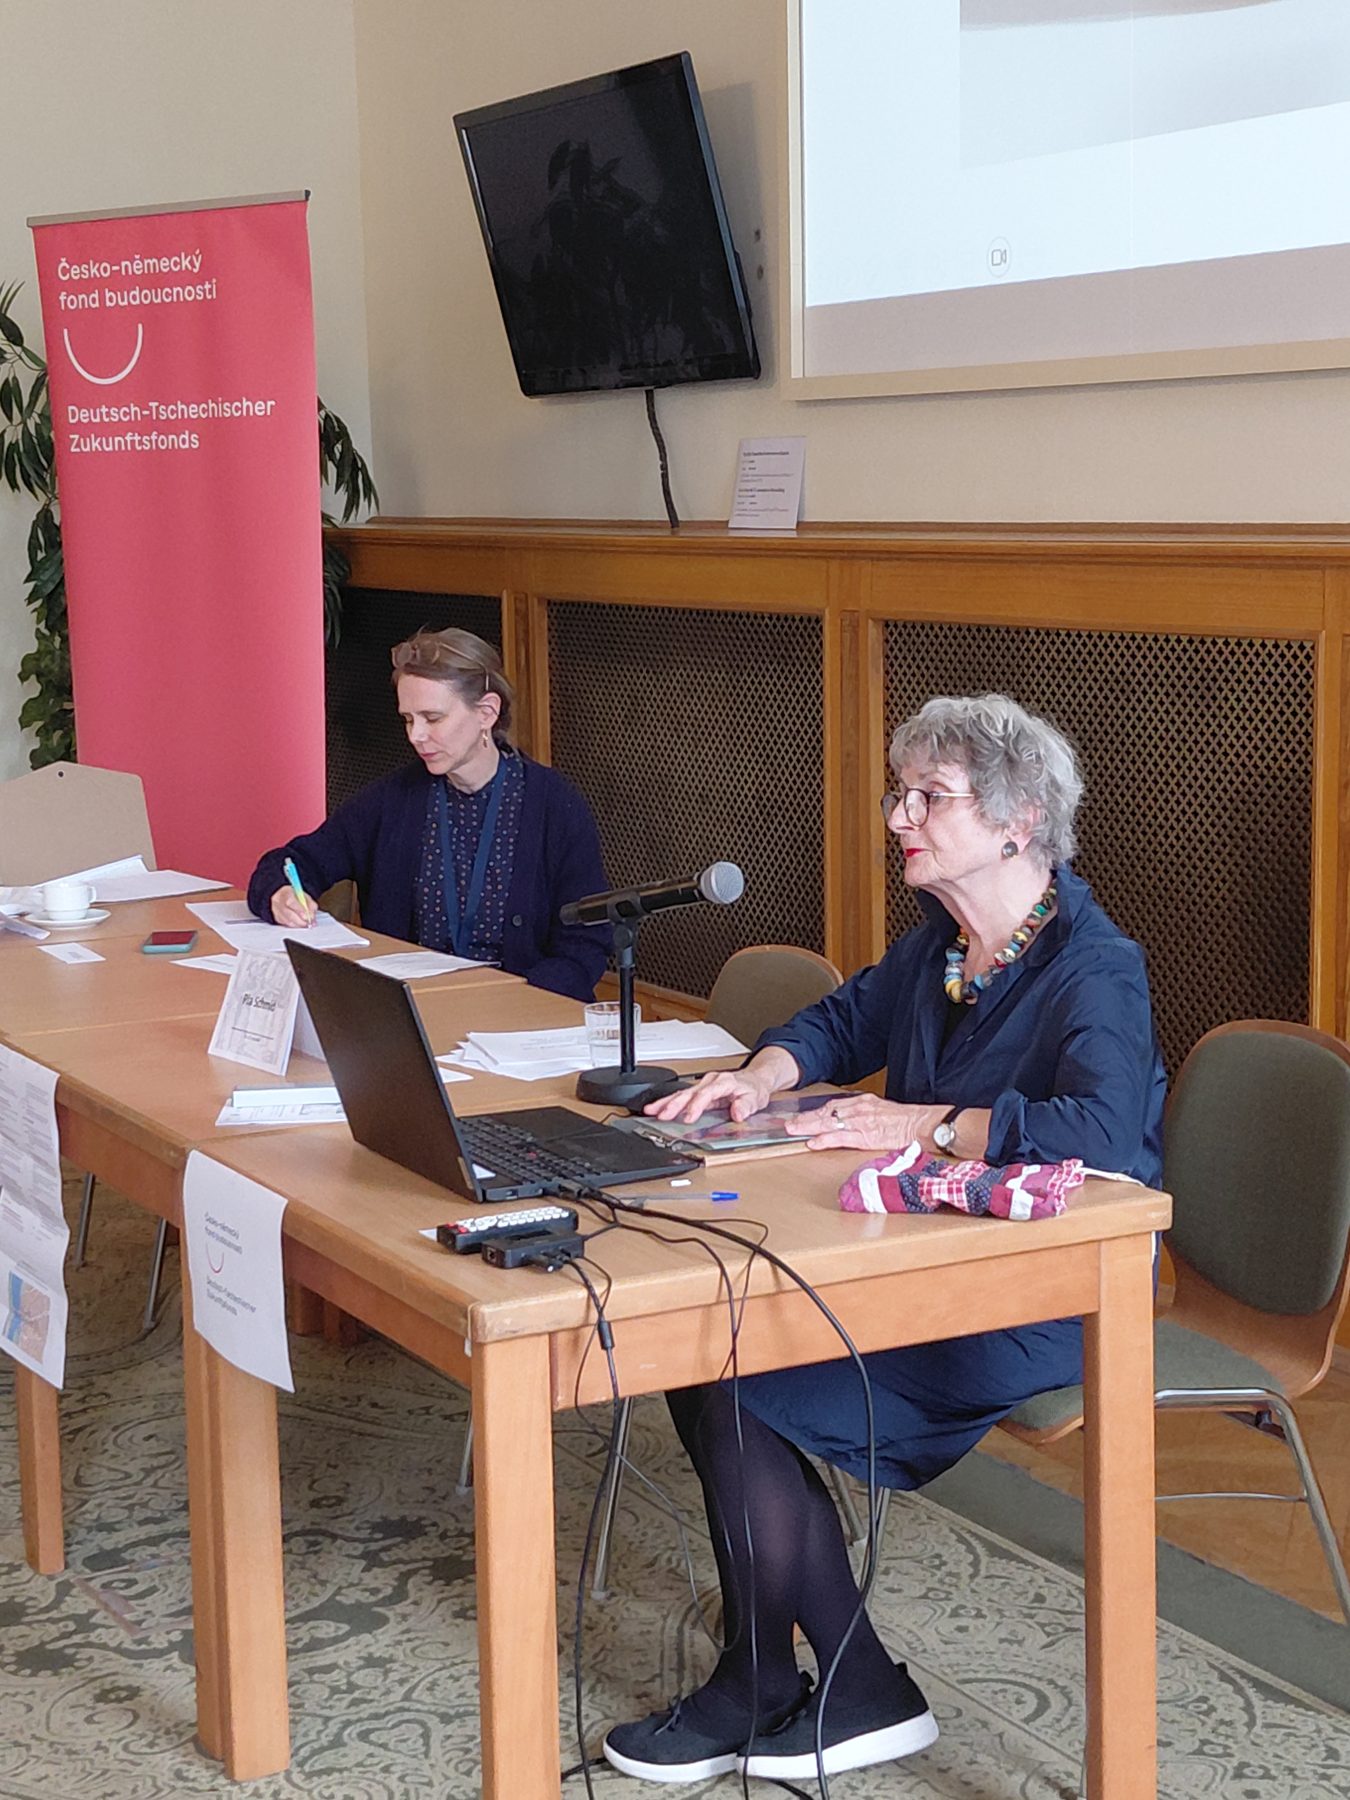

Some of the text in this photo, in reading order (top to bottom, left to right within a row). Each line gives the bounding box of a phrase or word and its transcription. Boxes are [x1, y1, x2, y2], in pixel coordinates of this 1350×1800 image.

[57, 249, 202, 280] Česko-německý
[59, 278, 217, 310] fond budoucnosti
[67, 397, 276, 424] Deutsch-Tschechischer
[69, 431, 200, 452] Zukunftsfonds
